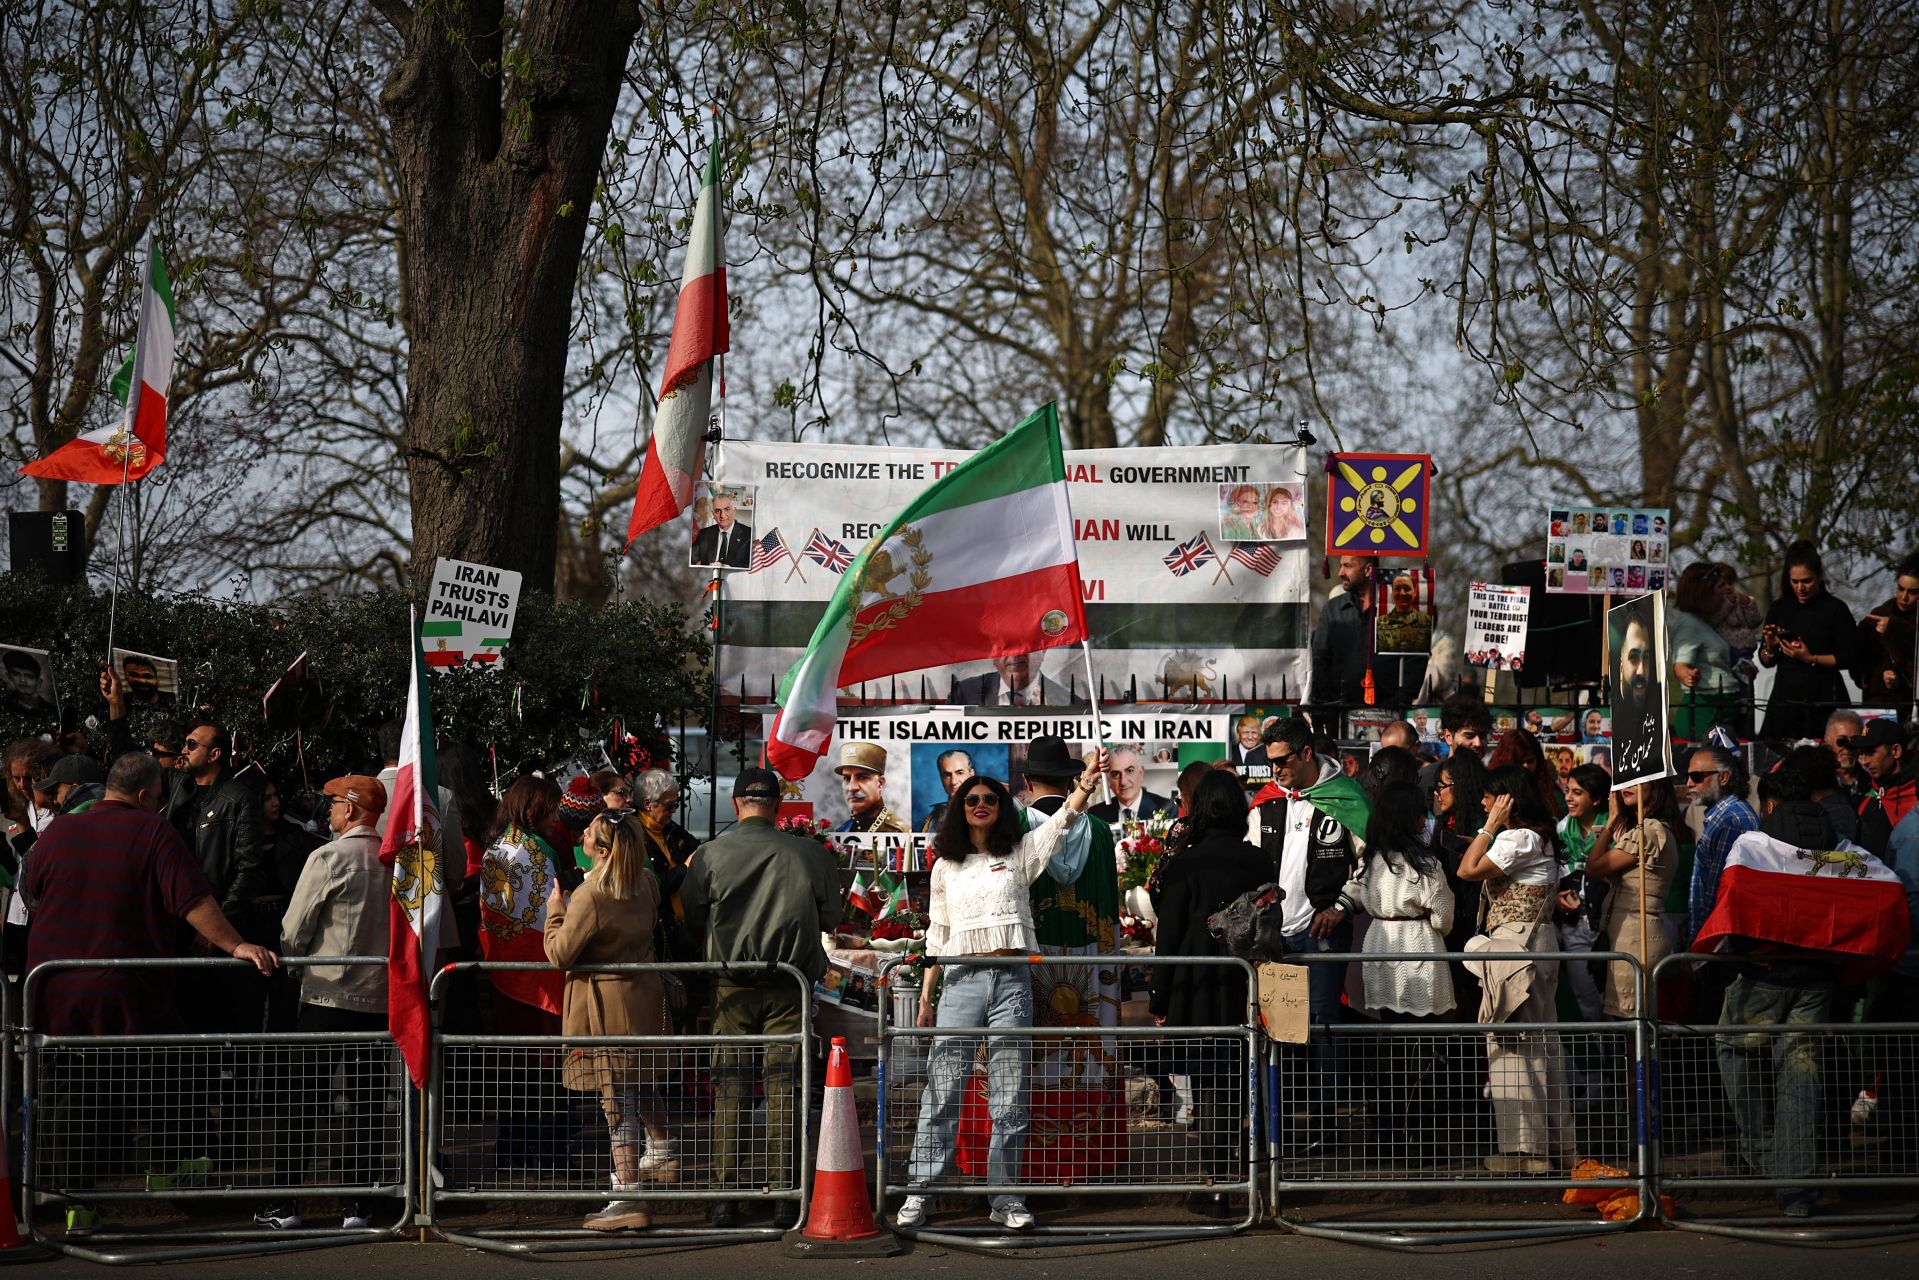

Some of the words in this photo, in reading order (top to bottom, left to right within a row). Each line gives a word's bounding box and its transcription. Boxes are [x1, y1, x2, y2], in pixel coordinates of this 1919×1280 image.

[765, 462, 881, 480] RECOGNIZE
[885, 463, 925, 480] THE
[1065, 464, 1103, 483] NAL
[1109, 465, 1251, 484] GOVERNMENT
[1074, 519, 1120, 541] IAN
[1126, 524, 1176, 541] WILL
[454, 565, 500, 588] IRAN
[439, 581, 510, 609] TRUSTS
[1081, 579, 1105, 601] VI
[1473, 592, 1487, 601] THIS
[1488, 593, 1496, 601] IS
[1497, 594, 1508, 603] THE
[1510, 595, 1527, 604] FINAL
[431, 599, 509, 629] PAHLAVI
[1470, 609, 1488, 619] YOUR
[1490, 610, 1528, 622] TERRORIST
[1488, 602, 1510, 611] BATTLE
[1474, 621, 1505, 633] LEADERS
[1507, 625, 1521, 634] ARE
[1484, 633, 1509, 644] GONE!
[836, 720, 880, 740] THE
[889, 720, 989, 741] ISLAMIC
[998, 720, 1112, 740] REPUBLIC
[1120, 720, 1145, 740] IN
[1155, 720, 1212, 740] IRAN
[1248, 765, 1271, 777] TRUST
